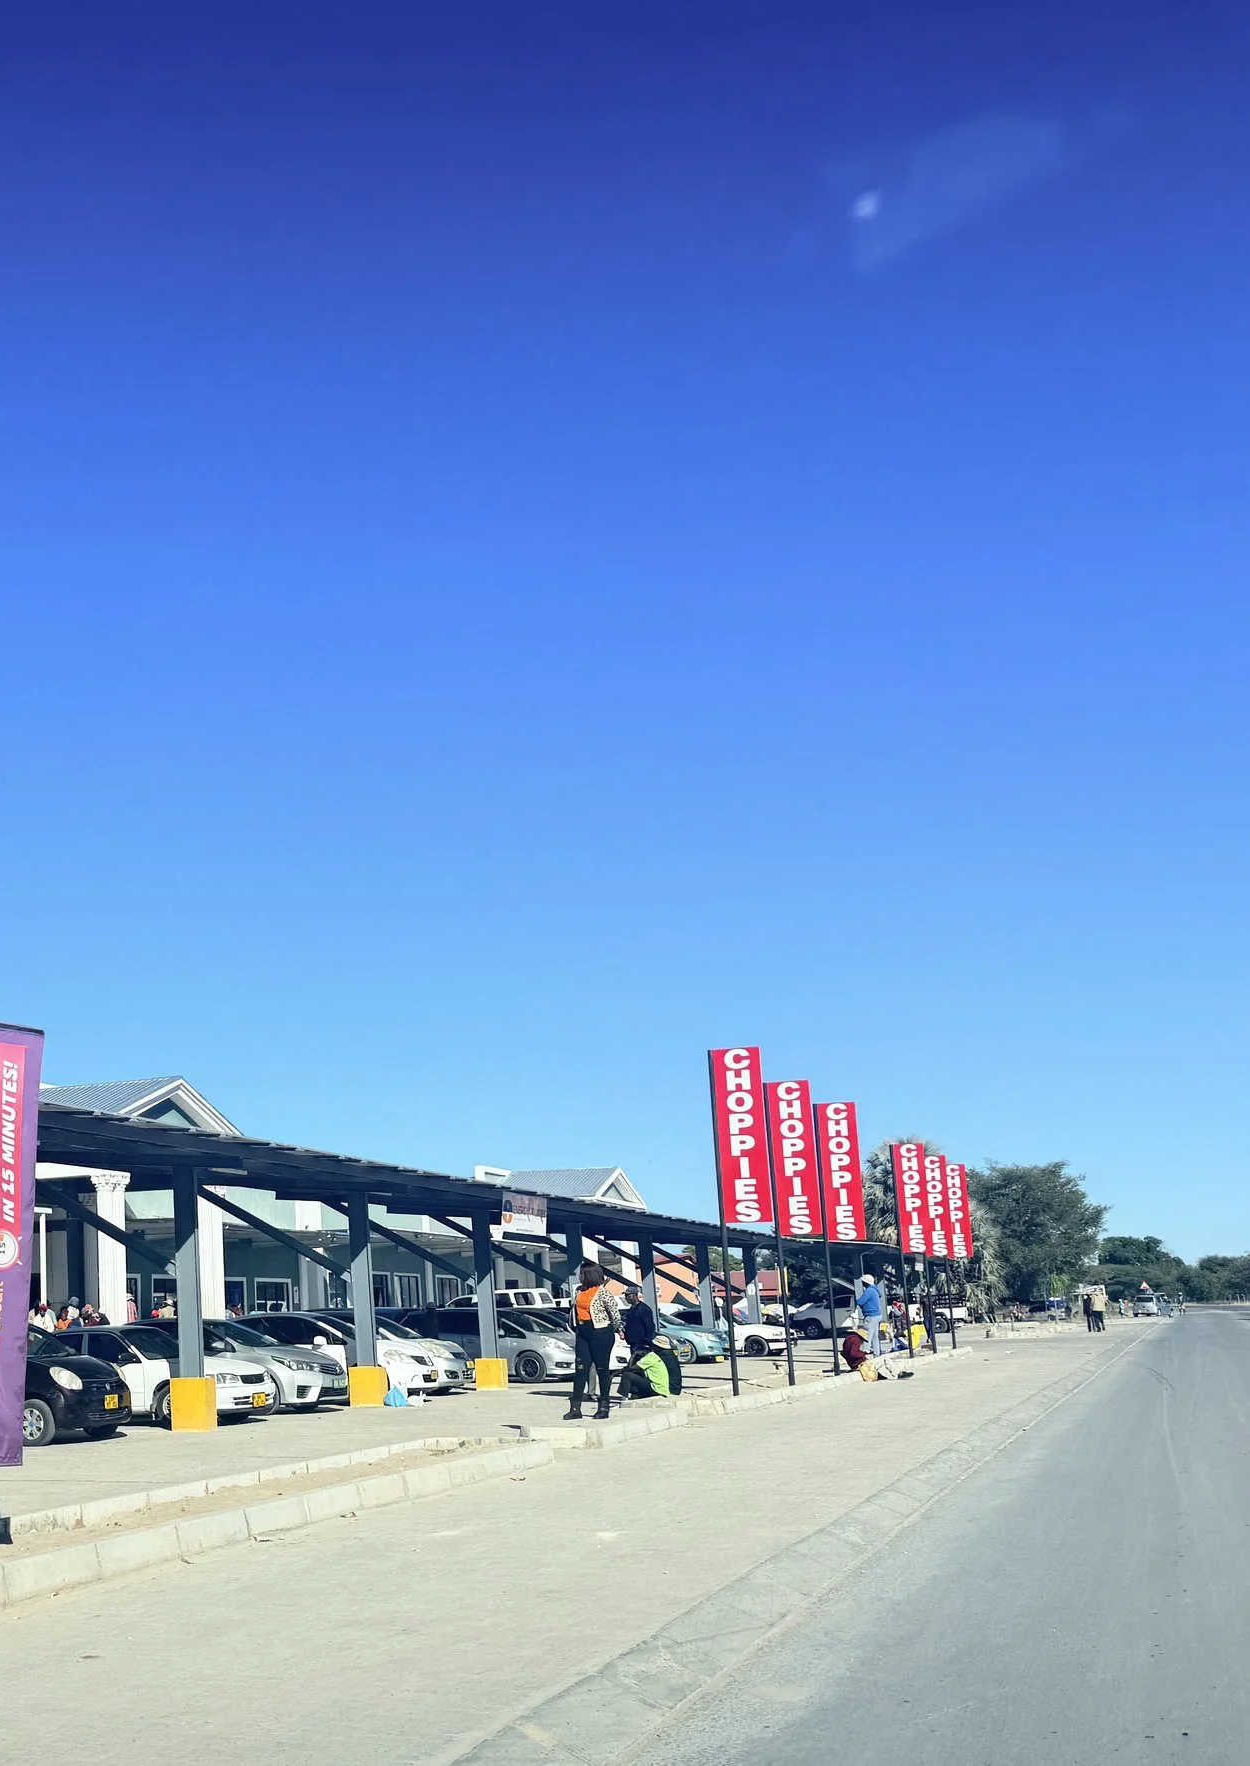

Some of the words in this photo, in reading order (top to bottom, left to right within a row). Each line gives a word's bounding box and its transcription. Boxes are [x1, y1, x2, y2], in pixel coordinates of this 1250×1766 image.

[2, 1060, 18, 1165] MINUTES!
[723, 1048, 762, 1222] CHOPPIES
[776, 1081, 813, 1235] CHOPPIES
[2, 1168, 15, 1196] 15
[2, 1197, 15, 1224] IN
[825, 1103, 858, 1240] CHOPPIES
[899, 1143, 927, 1253] CHOPPIES
[924, 1156, 949, 1257] CHOPPIES
[945, 1164, 968, 1258] CHOPPIES
